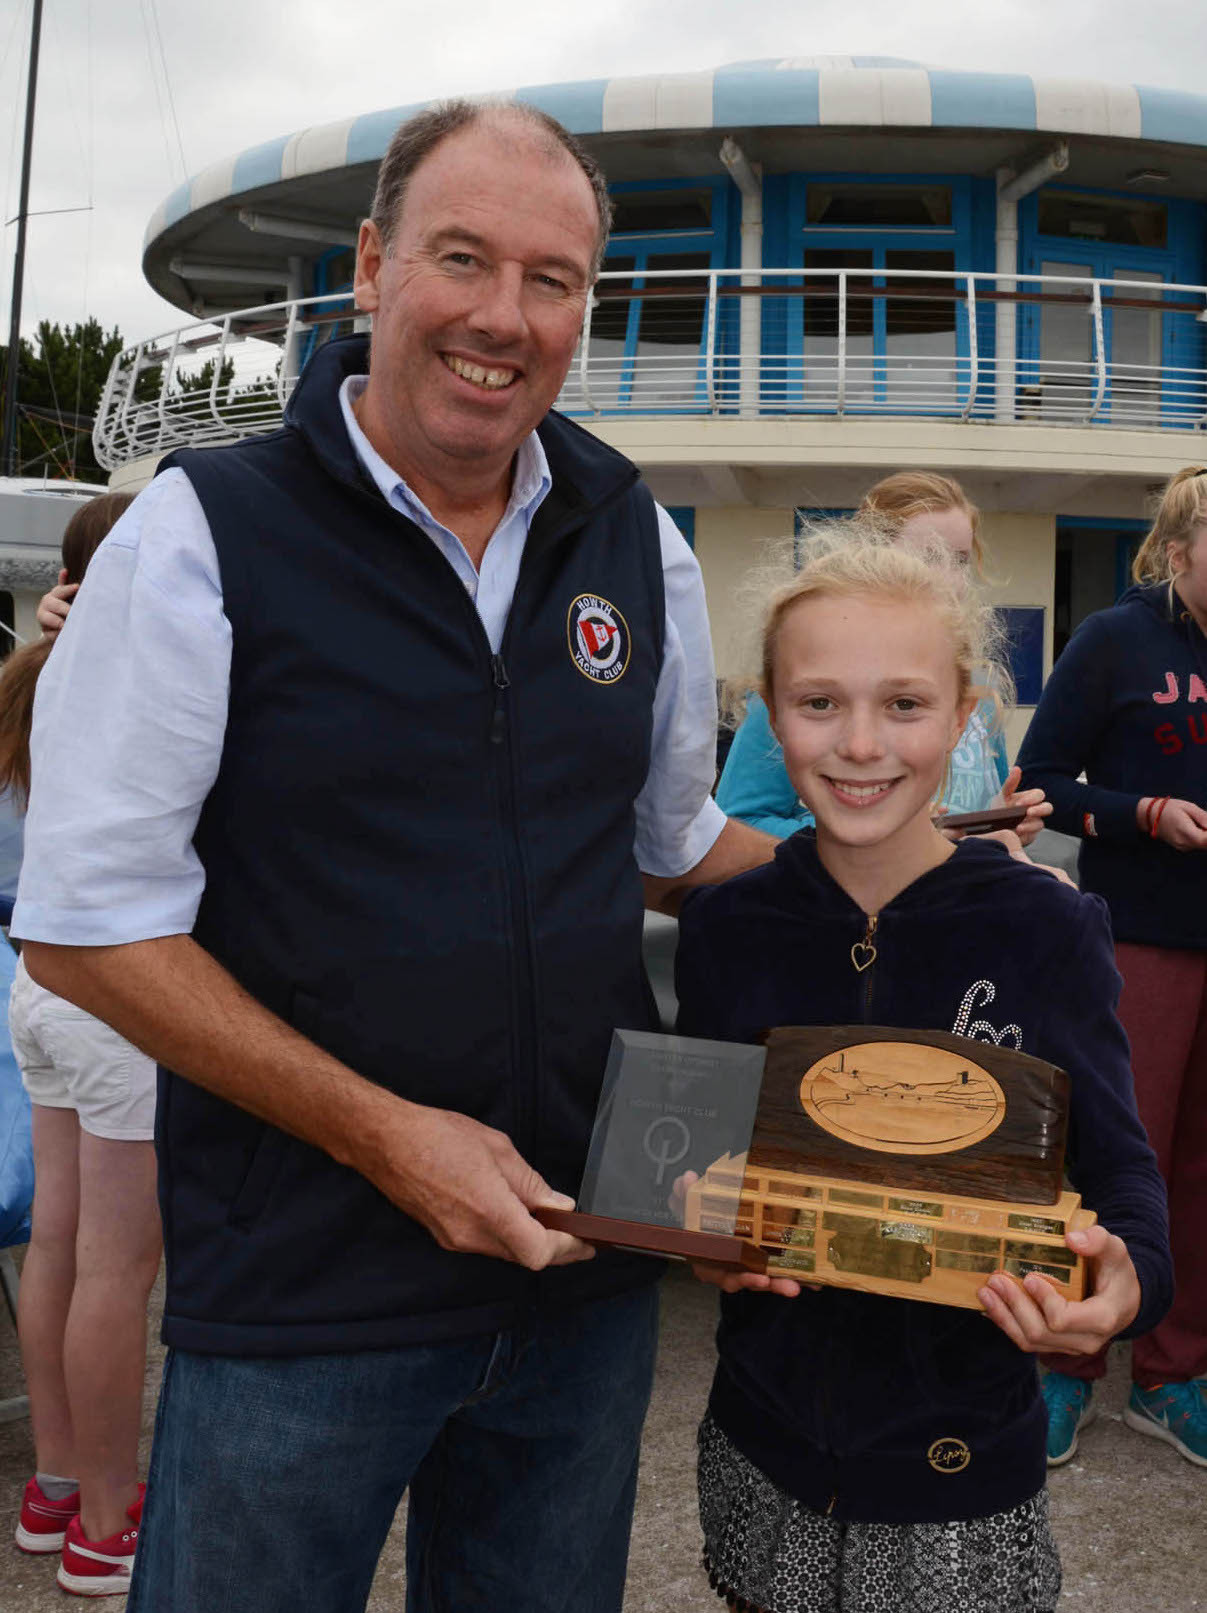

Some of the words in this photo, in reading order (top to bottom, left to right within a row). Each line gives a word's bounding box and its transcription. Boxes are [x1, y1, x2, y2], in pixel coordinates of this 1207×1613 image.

[577, 598, 612, 615] HOWTH
[576, 651, 600, 678] YACHT
[604, 661, 623, 680] CLUB
